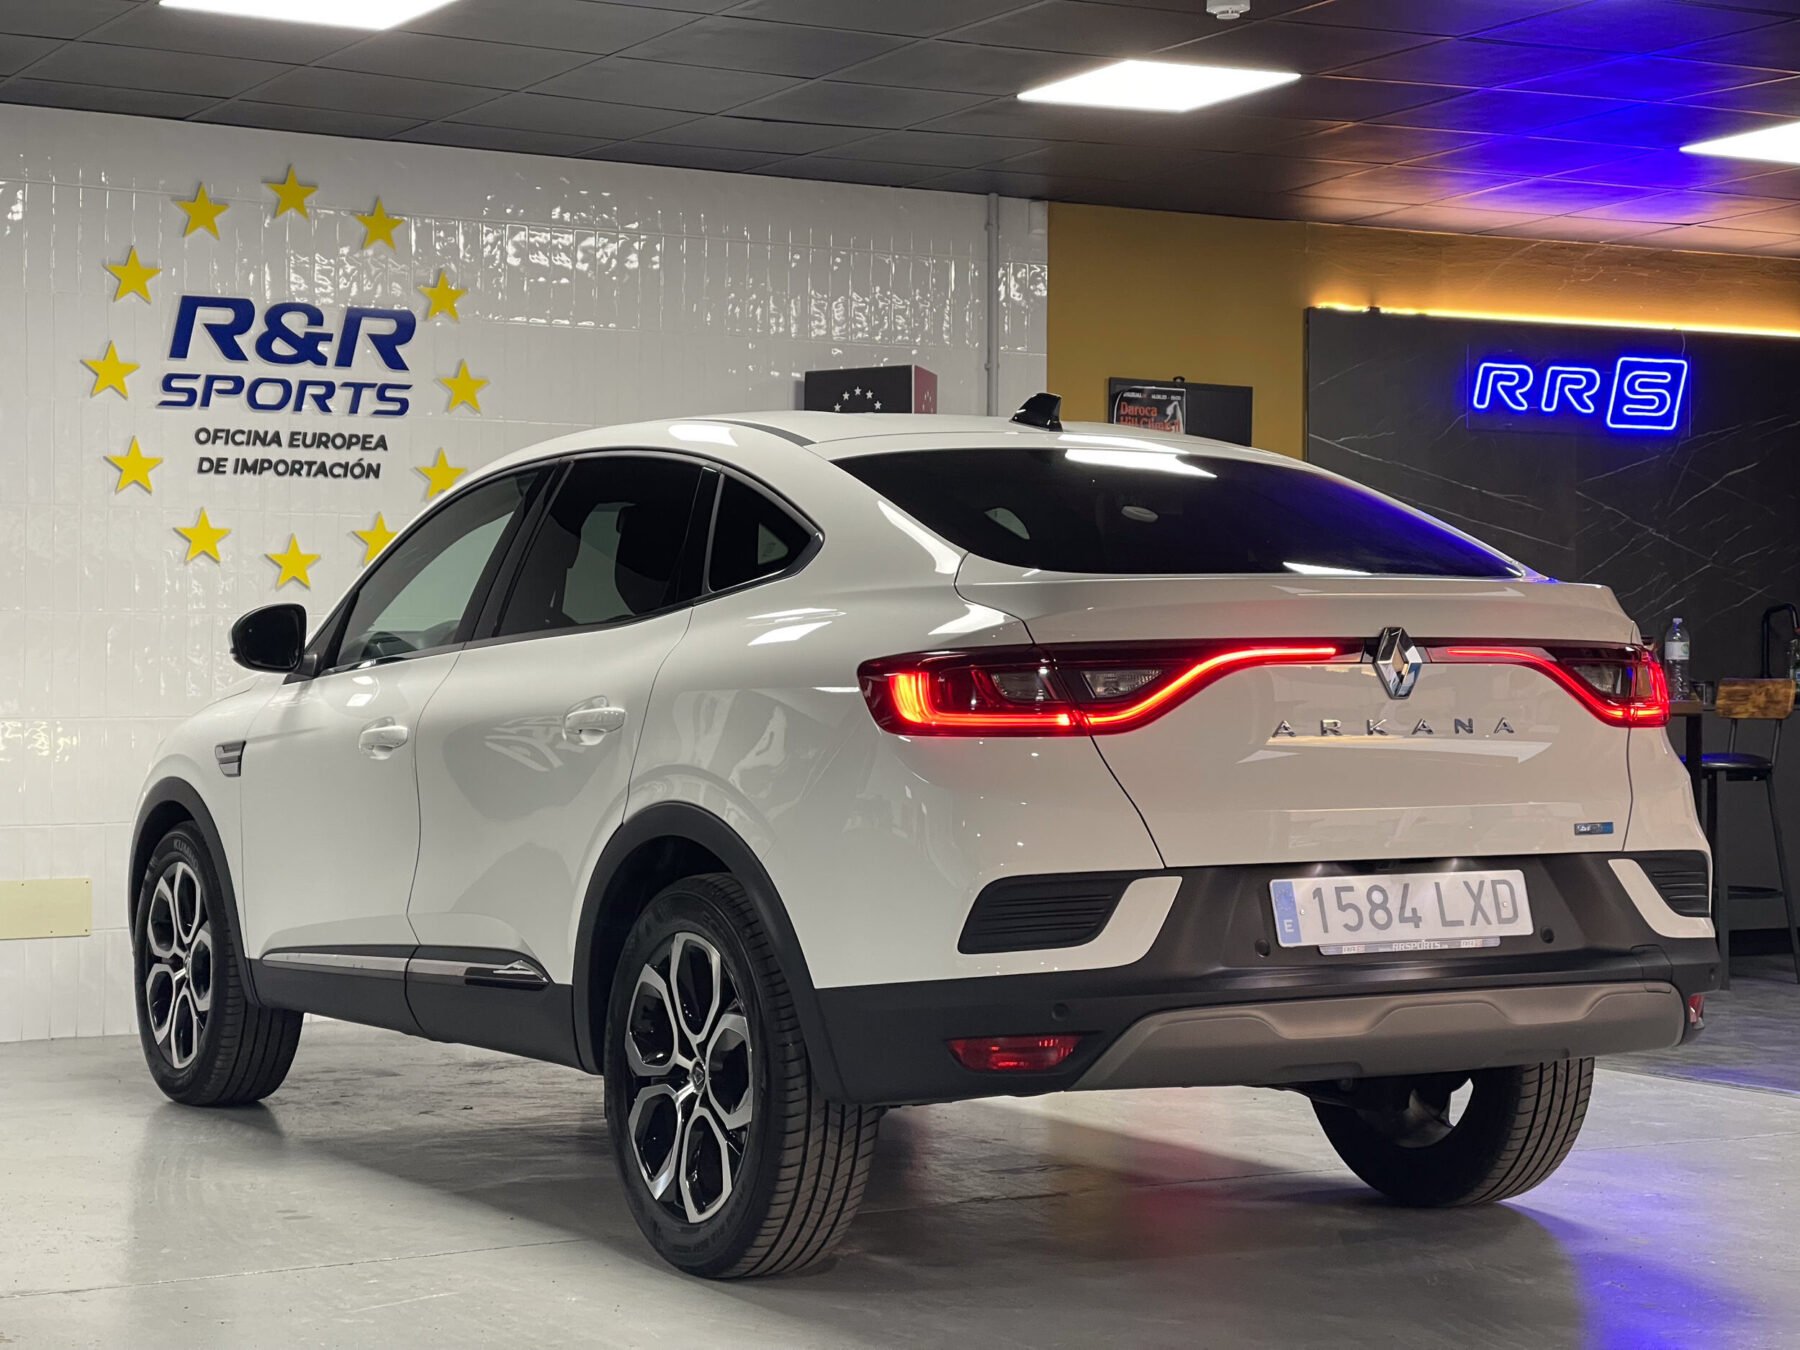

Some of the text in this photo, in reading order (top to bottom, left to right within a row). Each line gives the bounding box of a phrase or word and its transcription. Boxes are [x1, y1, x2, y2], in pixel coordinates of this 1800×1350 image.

[168, 295, 417, 371] R&R
[155, 373, 413, 416] SPORTS
[1473, 362, 1674, 417] RRS
[1120, 401, 1158, 416] Daroca
[194, 427, 389, 451] OFICINA EUROPEA
[197, 457, 381, 480] DE IMPORTACIÓN
[1272, 717, 1515, 738] ARKANA
[1312, 879, 1519, 934] 1584 LXD
[1284, 919, 1295, 933] E
